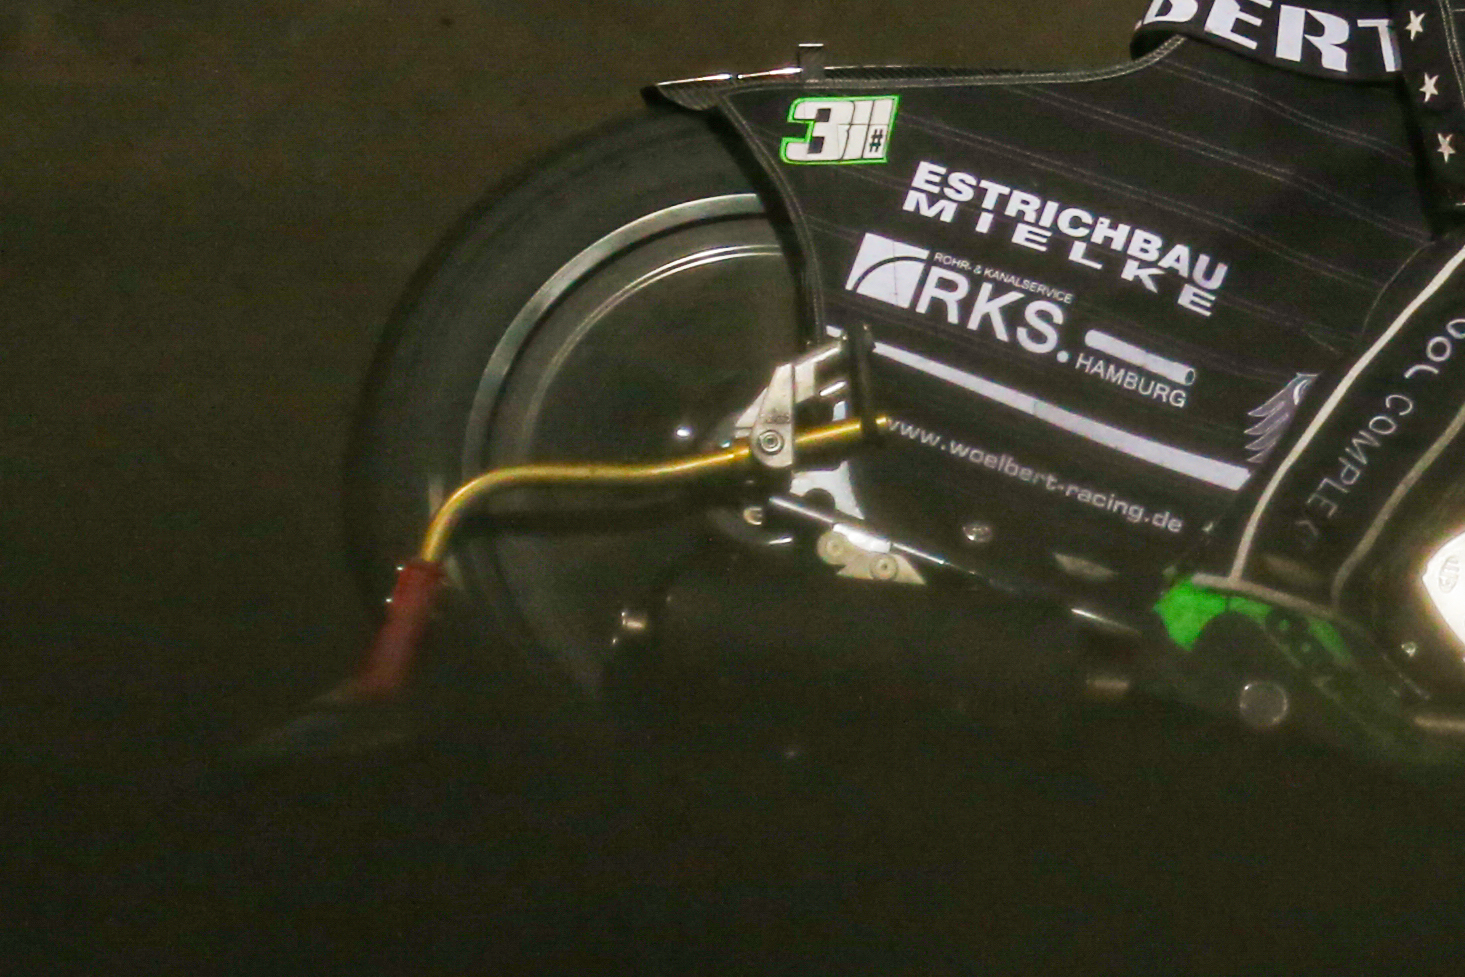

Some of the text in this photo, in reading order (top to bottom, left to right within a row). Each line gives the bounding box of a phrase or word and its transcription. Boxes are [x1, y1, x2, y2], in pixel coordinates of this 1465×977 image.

[902, 189, 1217, 318] MIELKE
[911, 160, 1228, 291] ESTRICHBAU
[915, 267, 1070, 364] RKS.
[1074, 352, 1187, 409] HAMBURG
